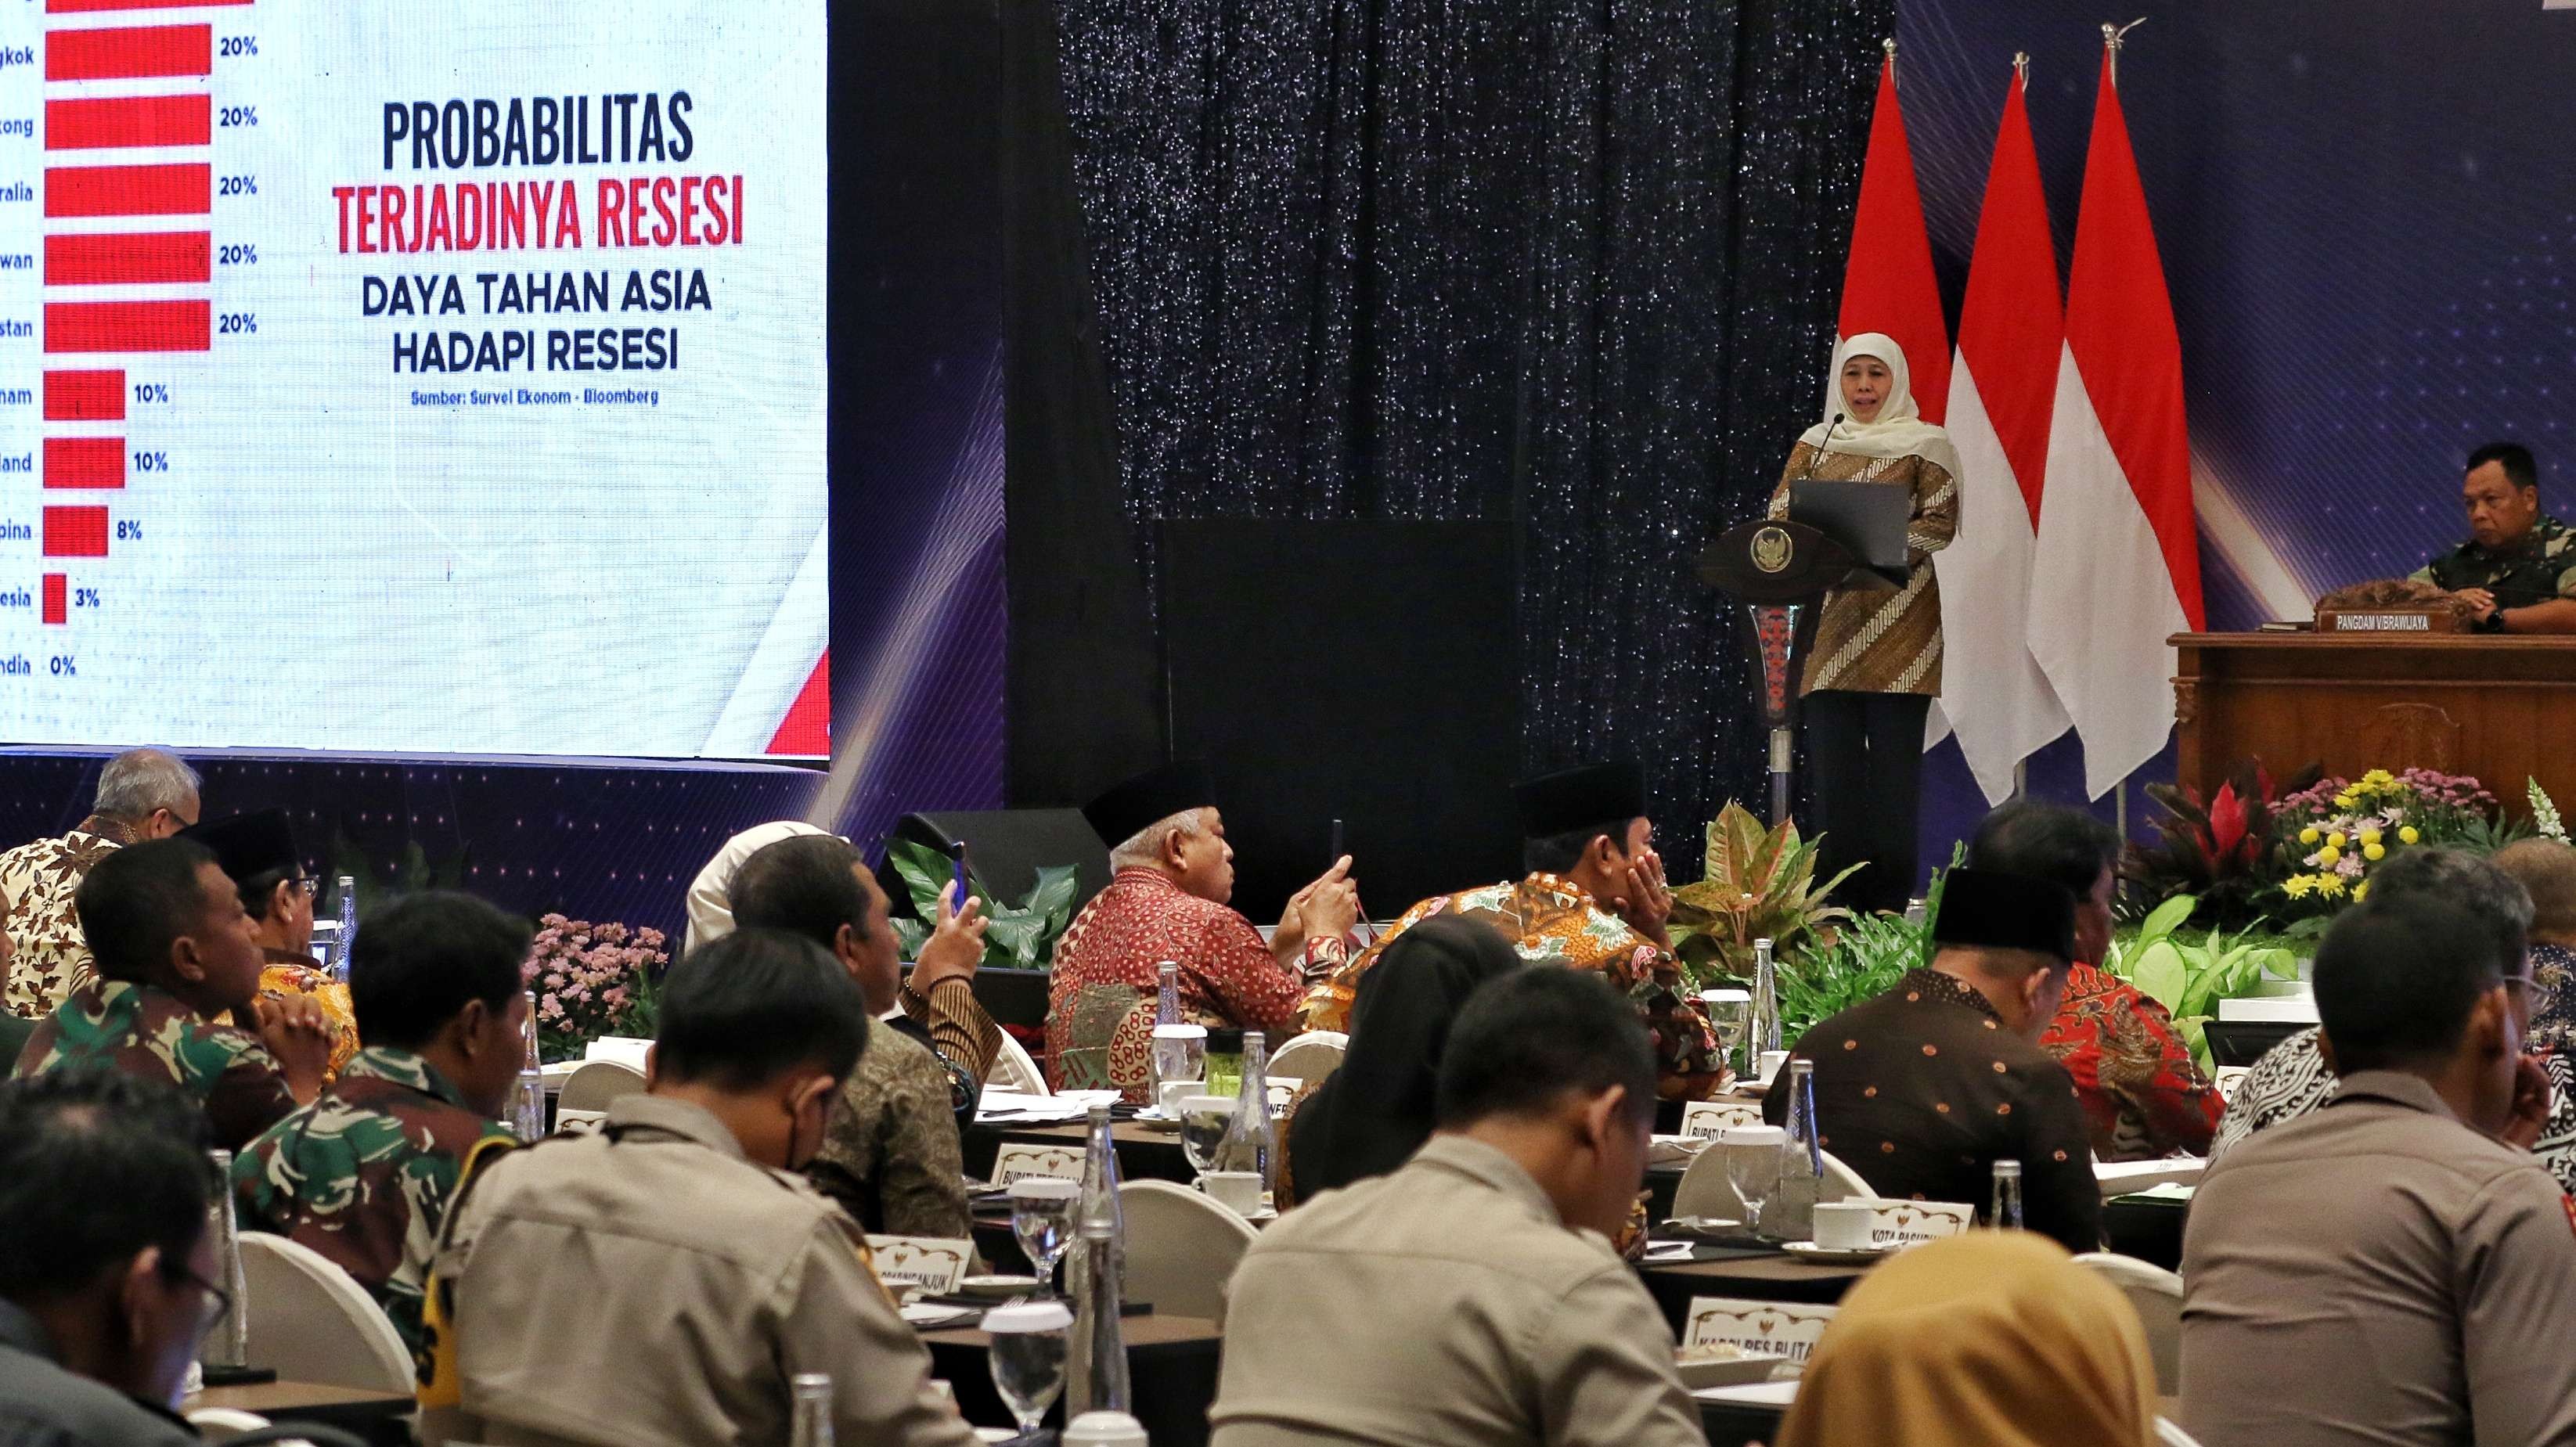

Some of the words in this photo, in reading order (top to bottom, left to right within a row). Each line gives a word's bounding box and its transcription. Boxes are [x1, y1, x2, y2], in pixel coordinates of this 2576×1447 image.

[220, 37, 258, 56] 20%
[220, 107, 258, 127] 20%
[0, 118, 33, 139] ong
[384, 91, 693, 170] PROBABILITAS
[220, 176, 258, 196] 20%
[332, 180, 582, 254] TERJADINYA
[597, 175, 743, 247] RESESI
[220, 245, 258, 265] 20%
[362, 274, 466, 316] DAYA
[476, 271, 609, 315] TAHAN
[621, 268, 712, 311] ASIA
[219, 314, 257, 333] 20%
[393, 330, 535, 373] HADAPI
[548, 328, 678, 371] RESESI
[135, 384, 168, 404] 10%
[411, 390, 466, 405] Sumber:
[517, 388, 571, 405] Ekonom
[583, 387, 659, 407] Bloomberg
[0, 452, 32, 472] and
[135, 452, 168, 471] 10%
[117, 520, 142, 540] 8%
[75, 589, 100, 608] 3%
[2336, 614, 2375, 631] PANGDAM
[50, 656, 76, 675] 0%
[1872, 1229, 1896, 1243] KOTA
